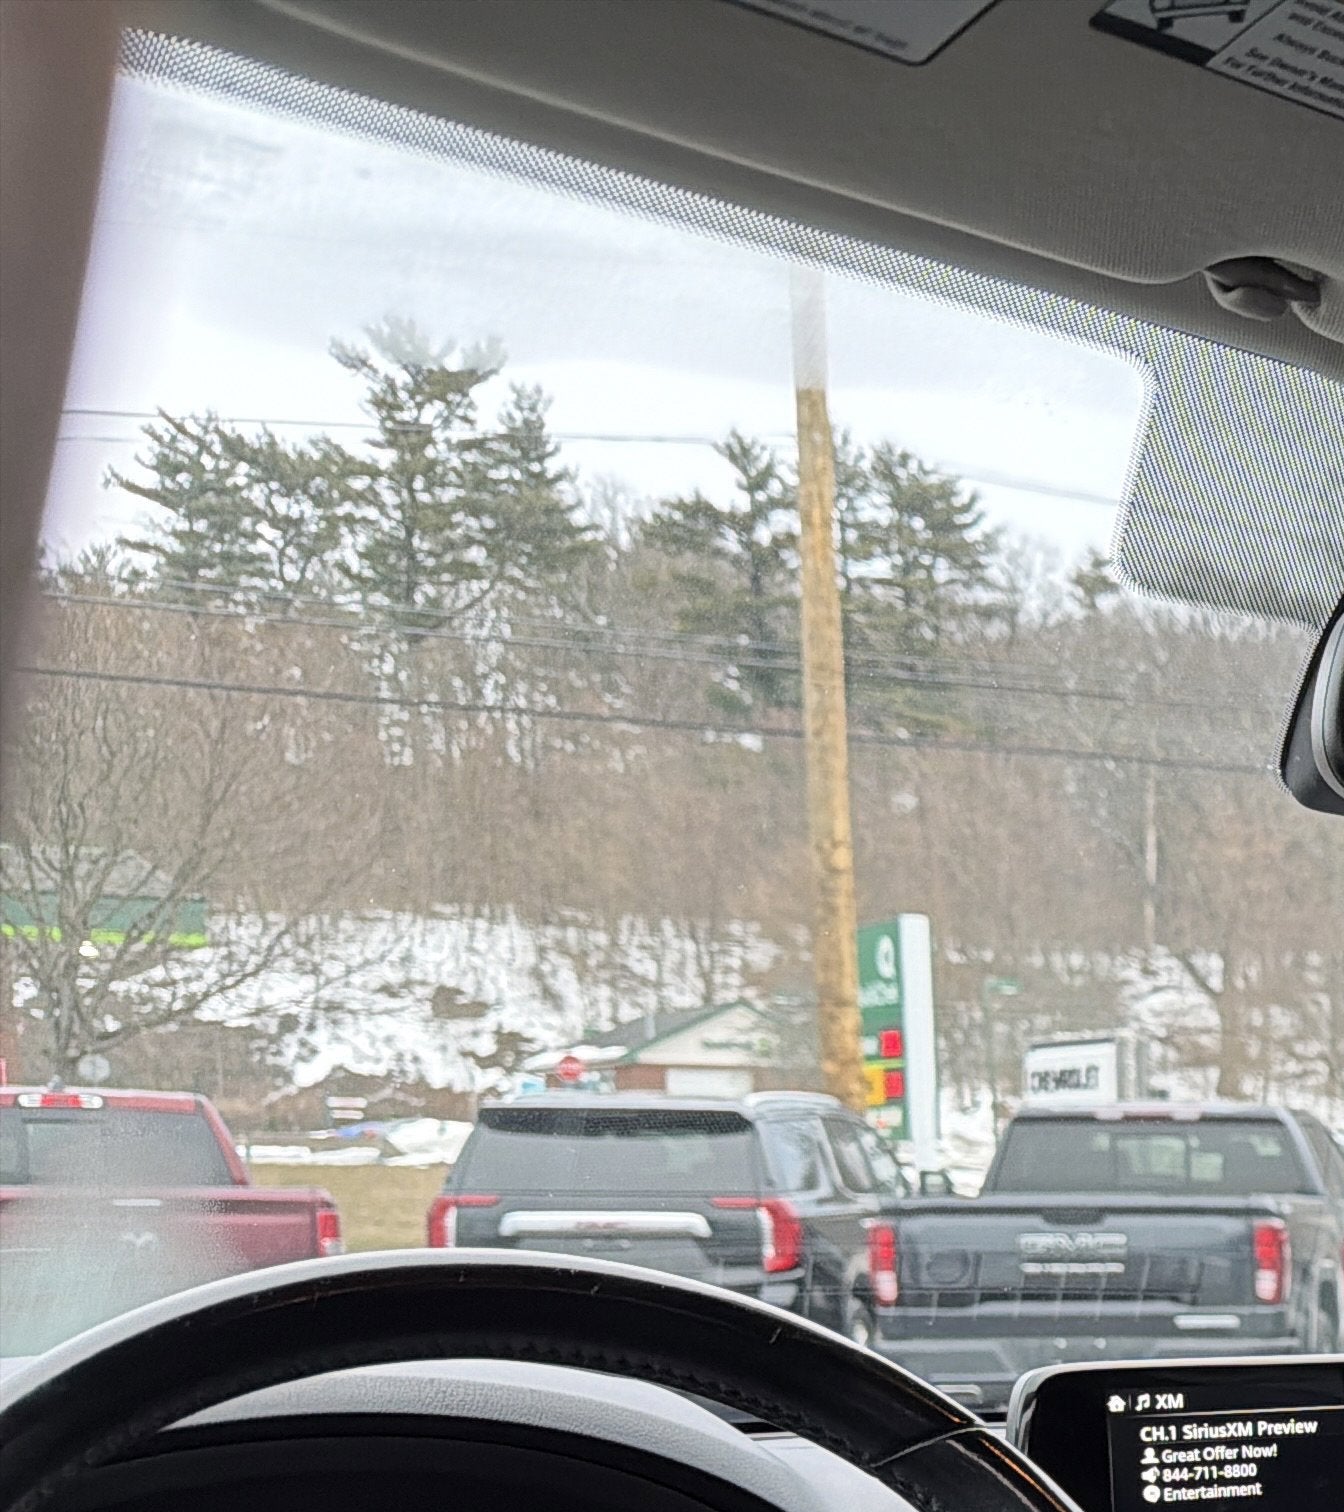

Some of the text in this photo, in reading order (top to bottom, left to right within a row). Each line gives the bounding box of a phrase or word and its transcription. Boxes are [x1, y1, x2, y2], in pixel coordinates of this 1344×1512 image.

[1155, 1393, 1184, 1410] XM
[1139, 1419, 1318, 1442] CH.1 SiriusXM Preview
[1161, 1443, 1278, 1464] Great Offer Now!
[1162, 1463, 1258, 1482] 844-711-8800
[1163, 1482, 1263, 1502] Entertainment
